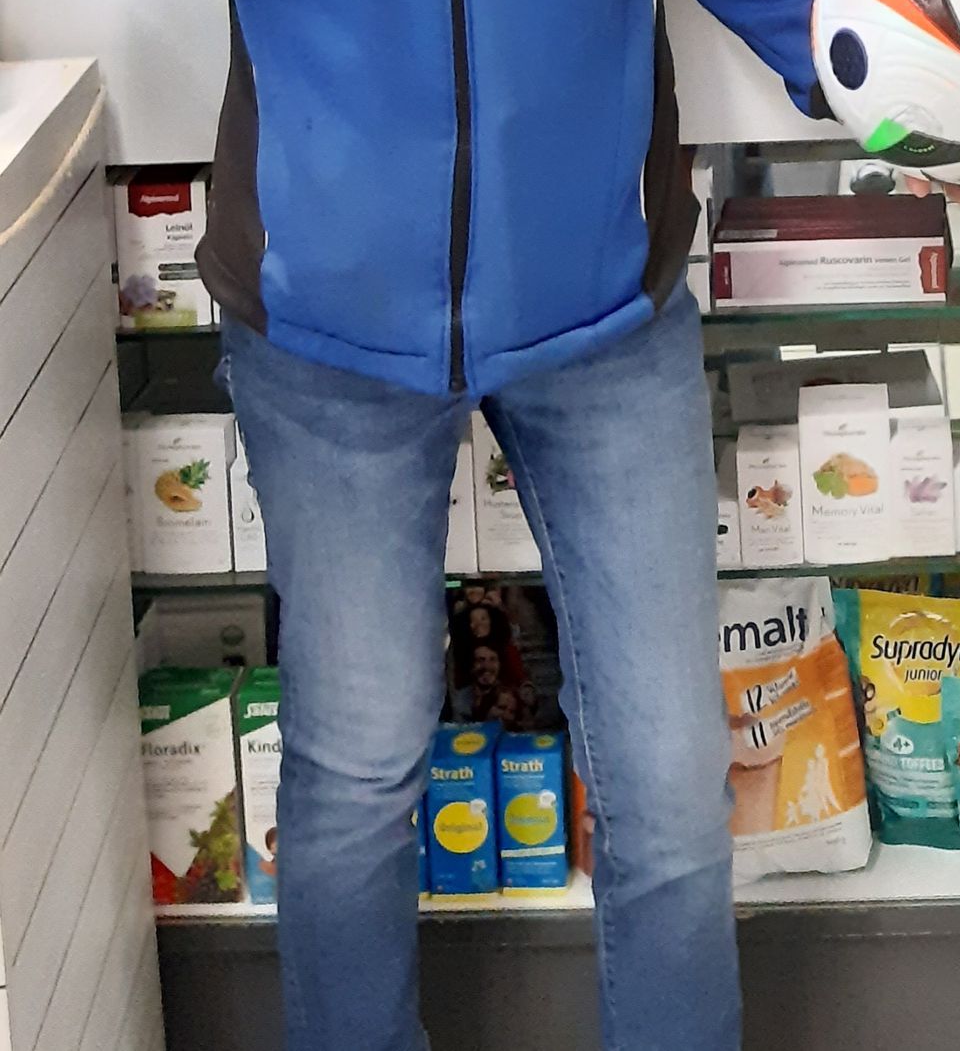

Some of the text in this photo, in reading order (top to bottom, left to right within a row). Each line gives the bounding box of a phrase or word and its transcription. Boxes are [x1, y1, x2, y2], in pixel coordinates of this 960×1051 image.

[819, 254, 873, 265] Ruscovarin
[811, 505, 859, 518] Memory
[718, 605, 809, 652] malt
[745, 684, 766, 714] 12
[501, 758, 545, 772] Strath
[430, 766, 474, 780] Strath
